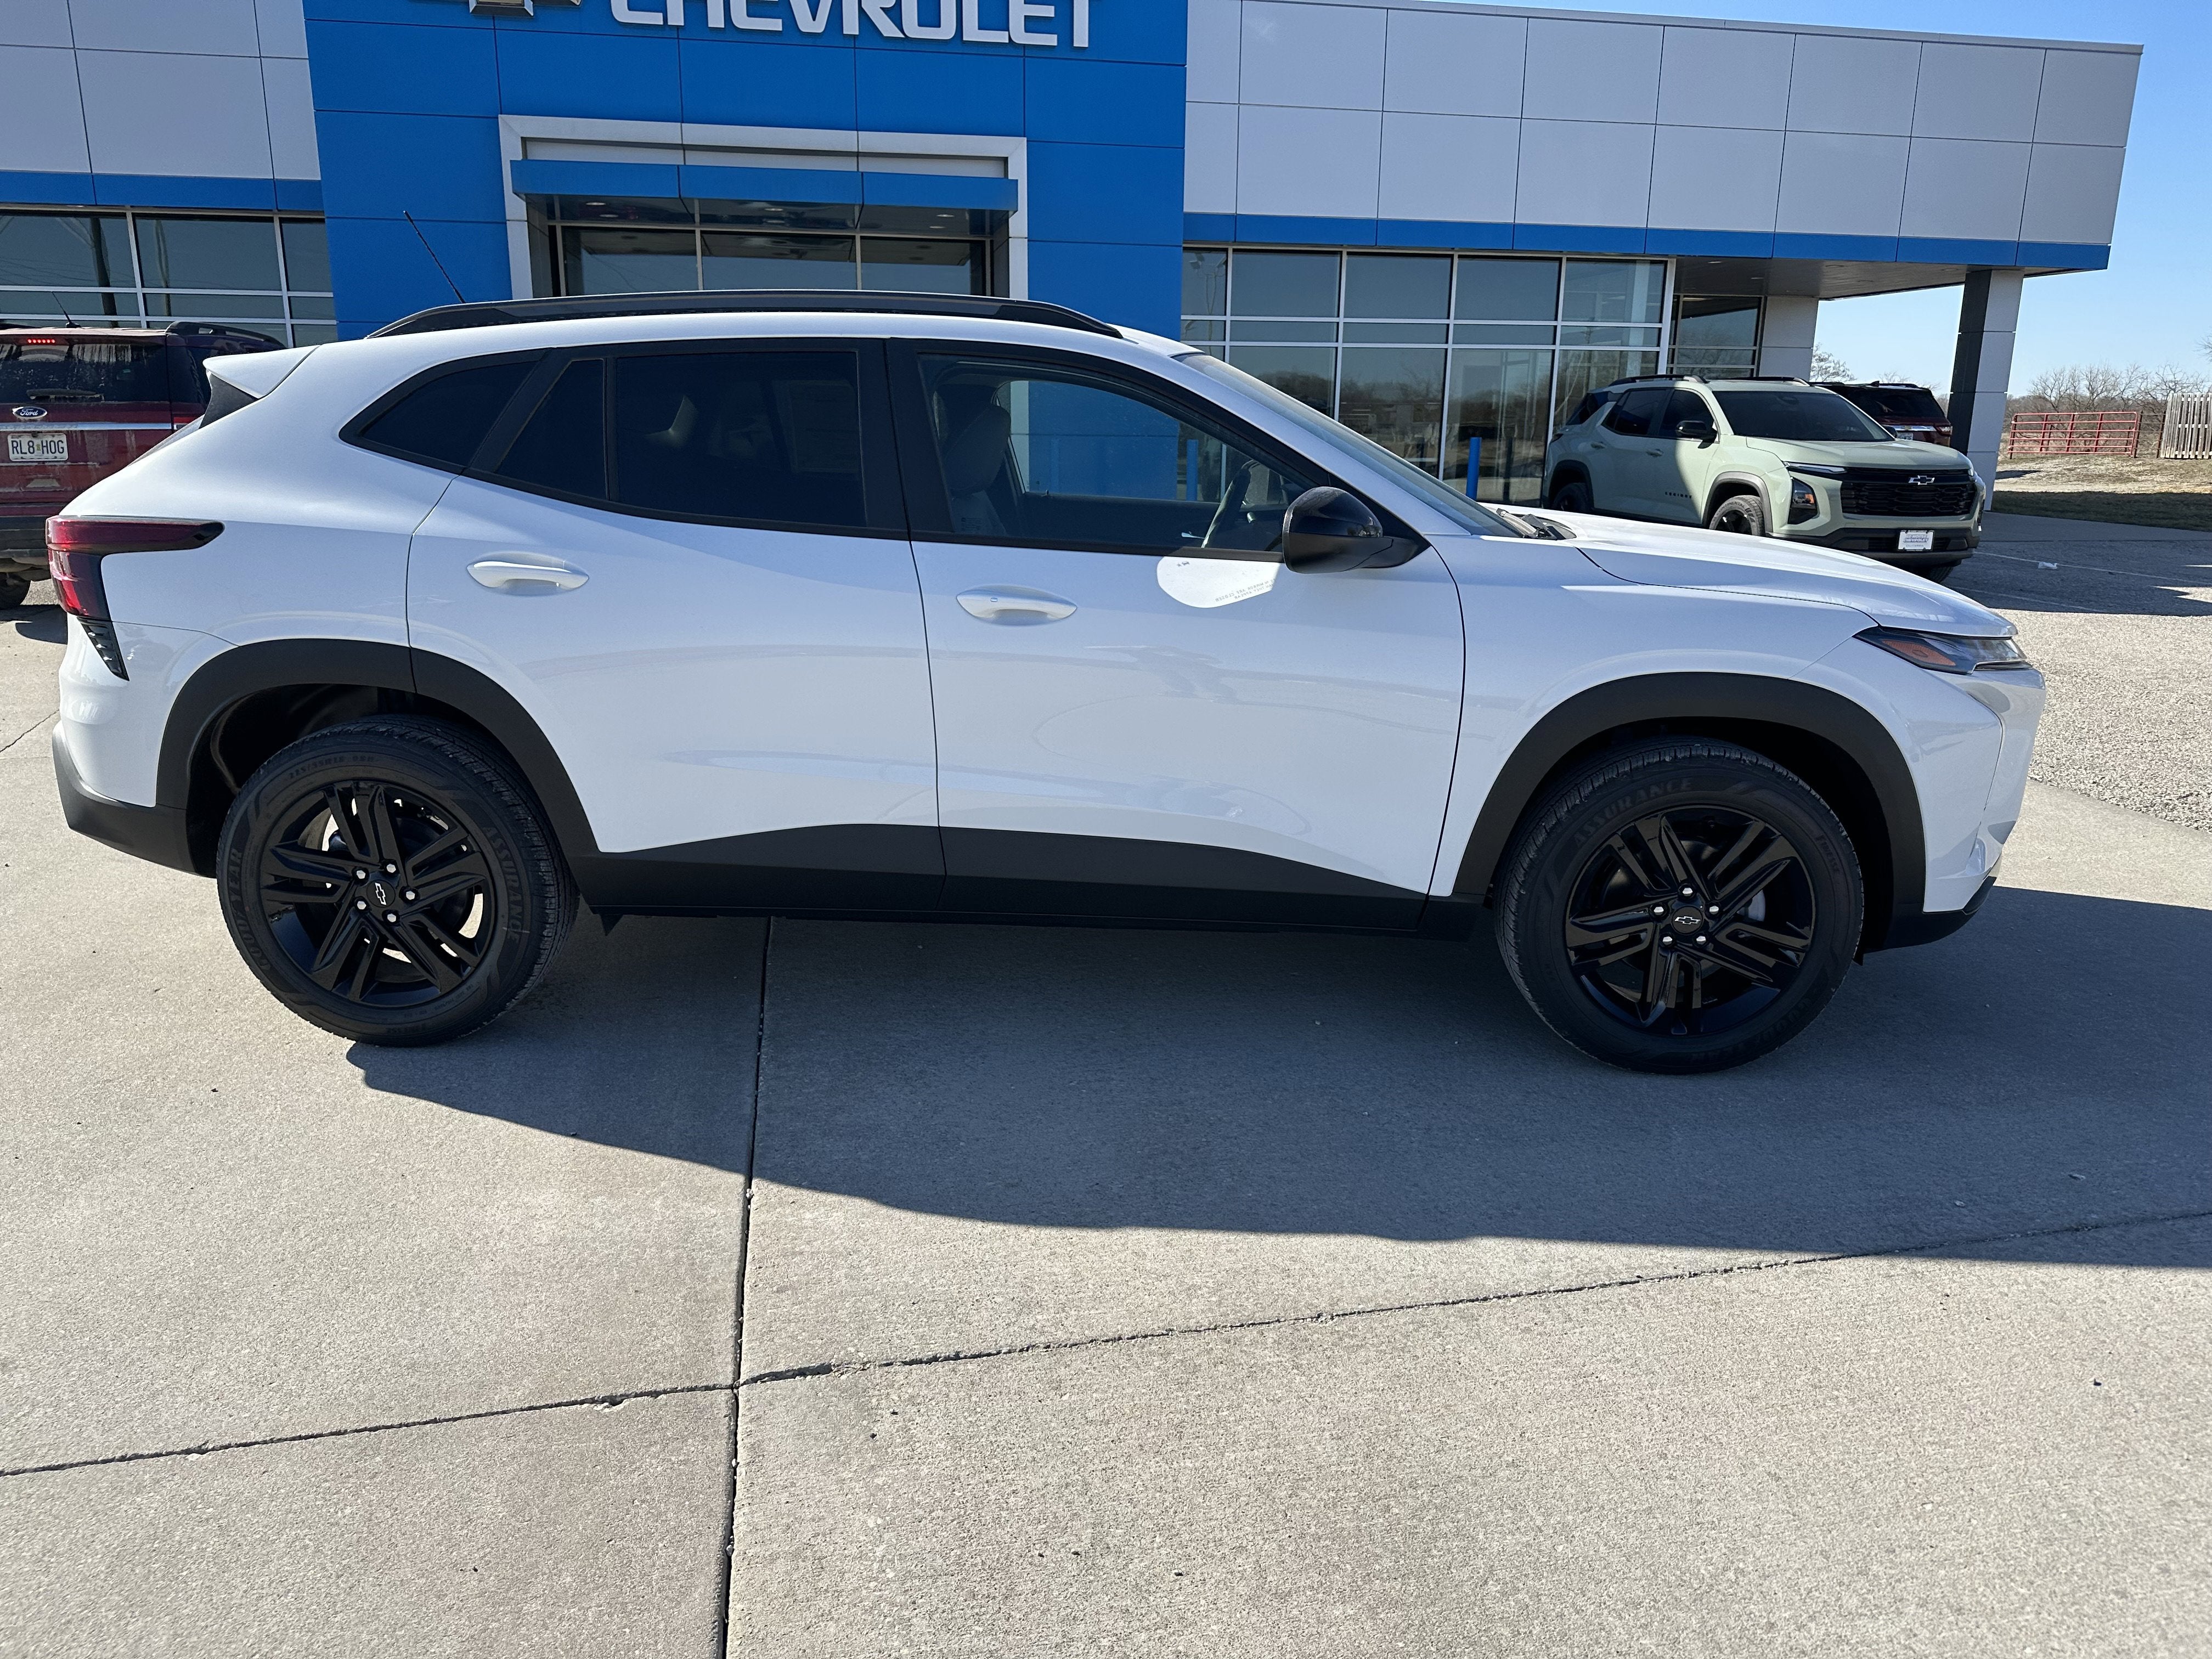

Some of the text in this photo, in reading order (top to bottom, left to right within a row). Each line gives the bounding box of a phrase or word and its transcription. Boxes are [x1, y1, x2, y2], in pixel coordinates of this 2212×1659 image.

[11, 439, 35, 455] RL8
[1574, 777, 1692, 848] ASSURANCE
[482, 827, 523, 944] ASSURANCE
